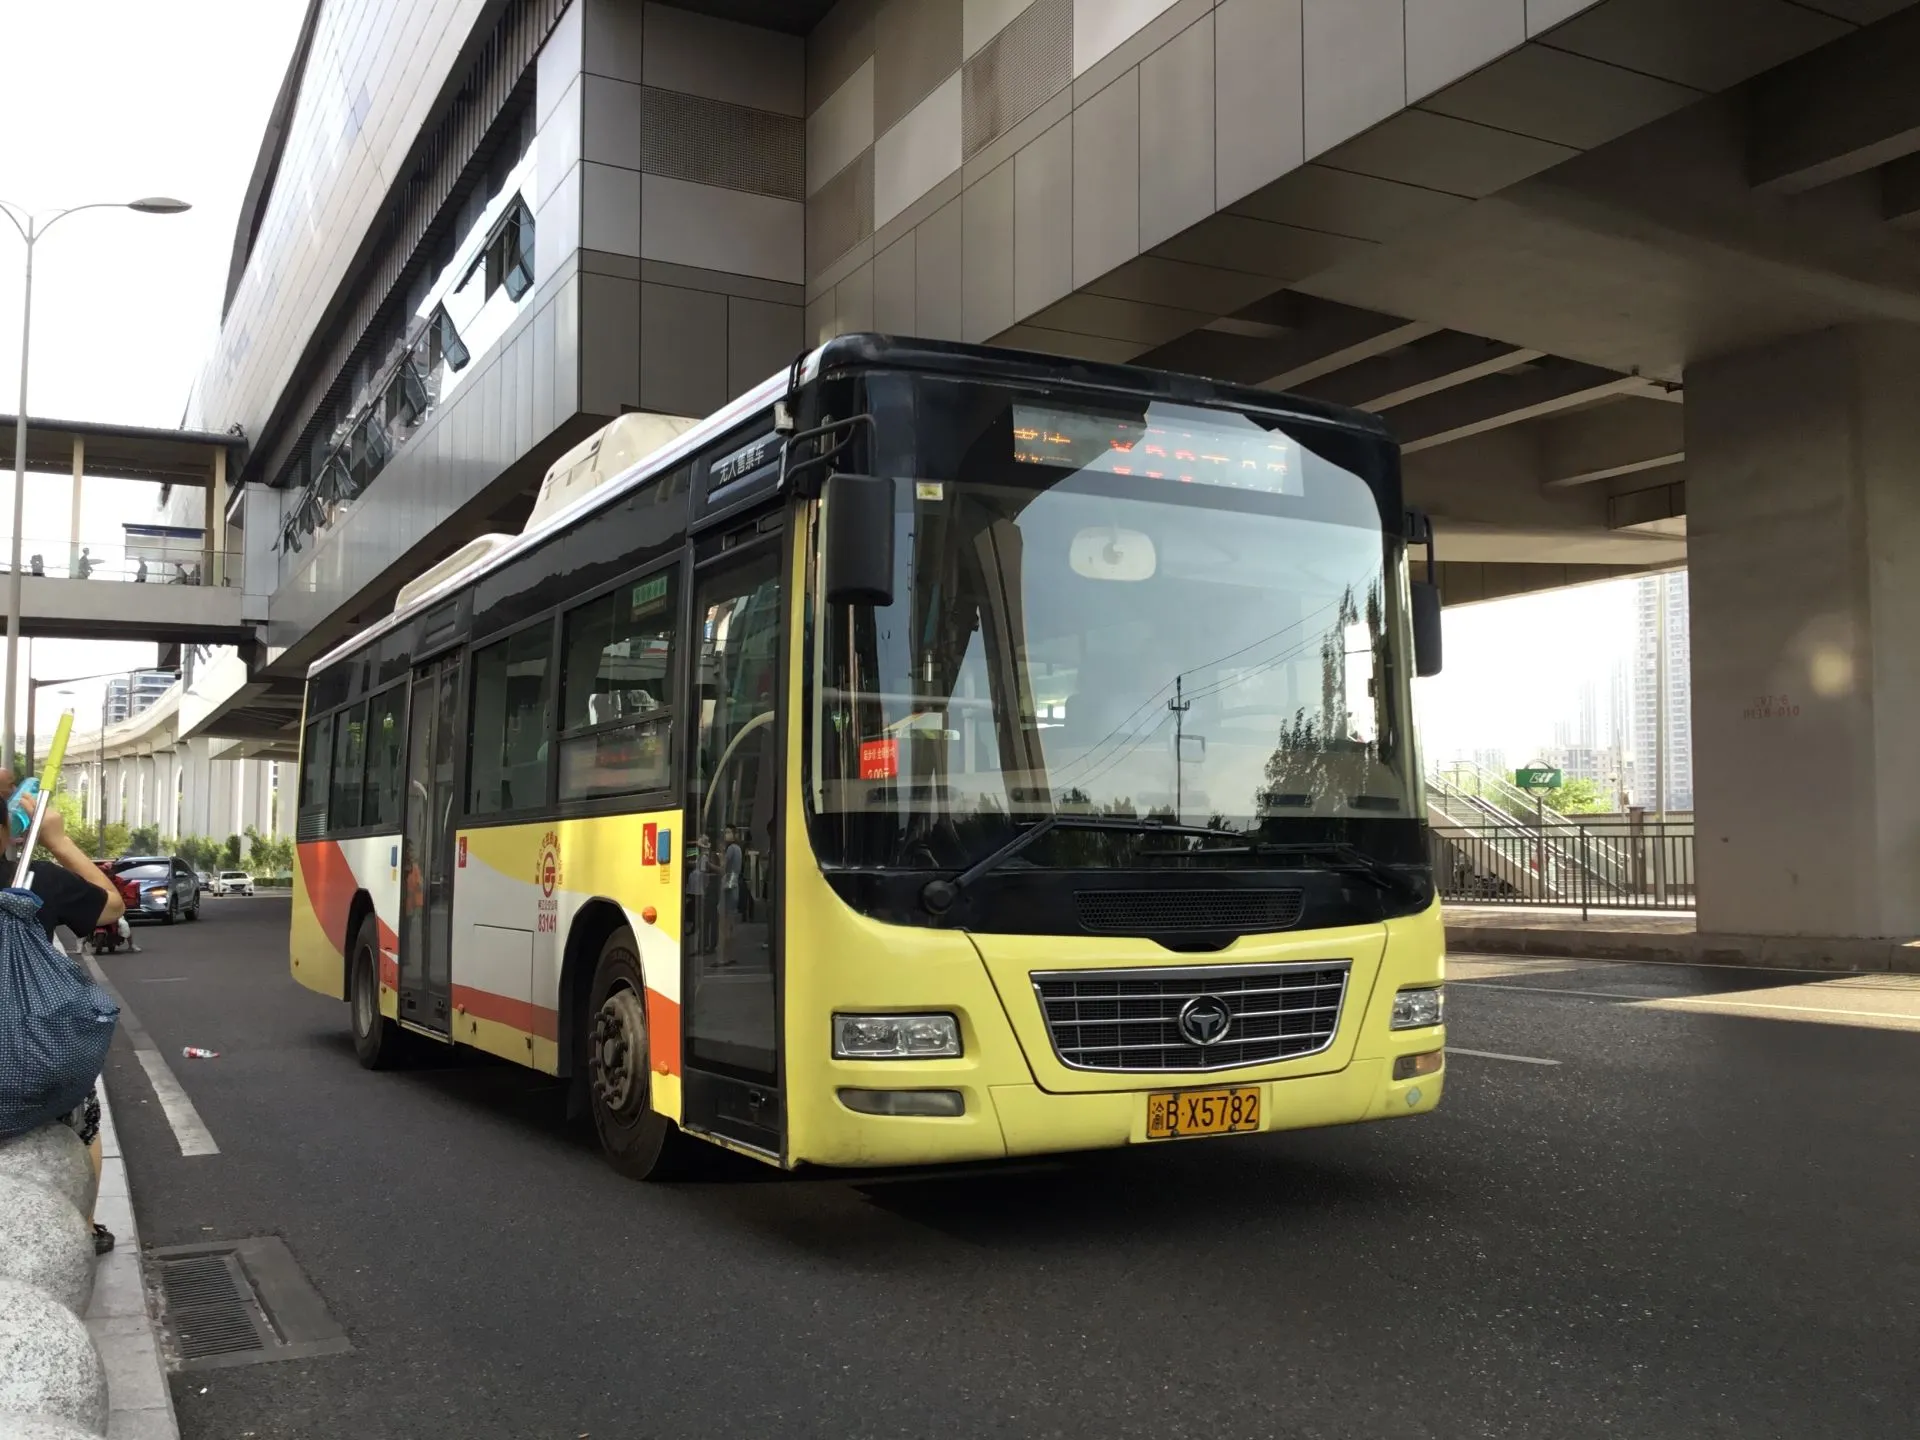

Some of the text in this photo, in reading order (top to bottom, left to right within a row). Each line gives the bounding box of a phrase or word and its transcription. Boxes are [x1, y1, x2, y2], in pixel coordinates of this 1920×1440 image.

[719, 443, 766, 485] 无人售票车
